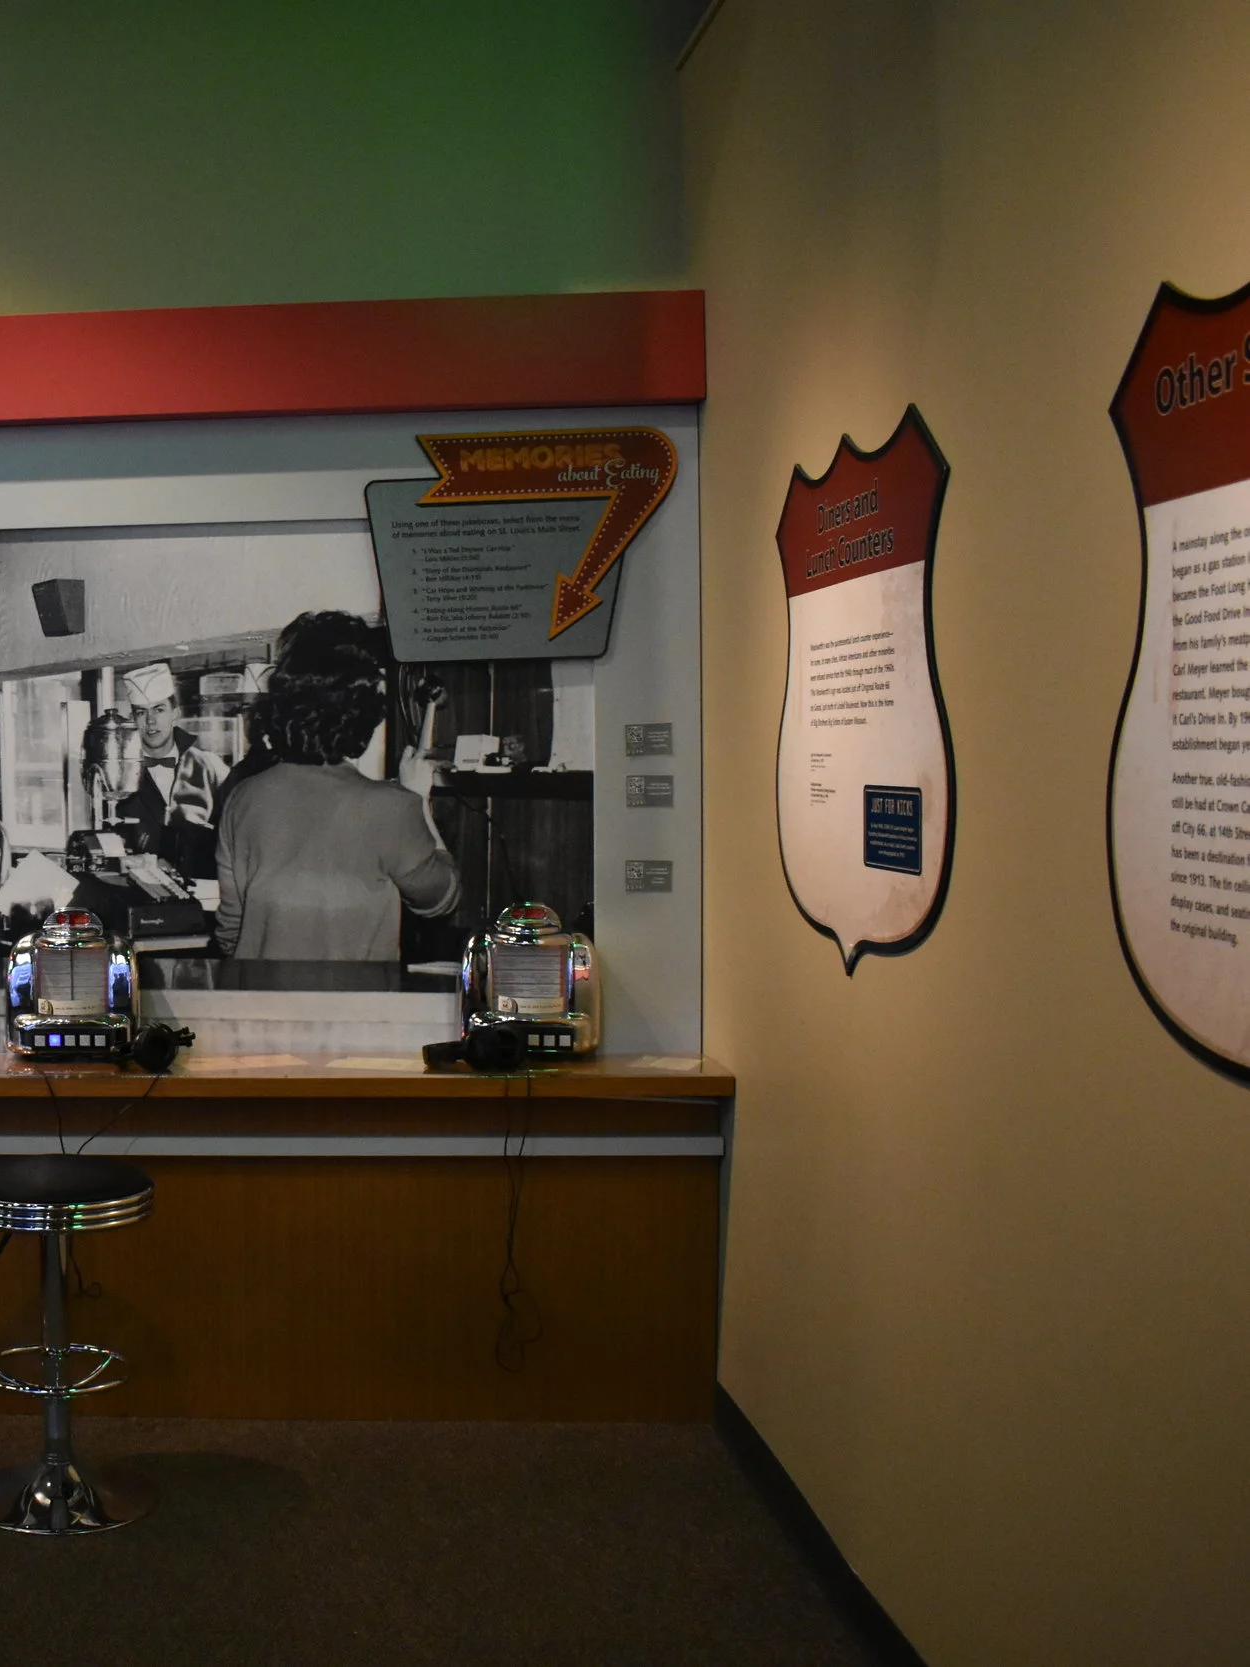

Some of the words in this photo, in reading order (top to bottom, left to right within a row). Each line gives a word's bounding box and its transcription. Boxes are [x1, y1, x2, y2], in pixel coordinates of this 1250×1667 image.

[1155, 349, 1238, 416] Other
[460, 443, 624, 472] MEMORIES
[557, 464, 600, 481] about
[604, 457, 659, 489] Eating
[817, 499, 851, 535] Diners
[854, 478, 878, 520] and
[392, 521, 413, 530] Using
[431, 519, 439, 527] of
[462, 528, 485, 538] eating
[1173, 540, 1177, 551] A
[1179, 536, 1207, 551] mainstay
[1210, 532, 1229, 546] along
[1230, 528, 1242, 540] the
[806, 539, 836, 579] Lunch
[838, 527, 894, 568] Counters
[1173, 564, 1191, 579] began
[1194, 564, 1200, 573] as
[1208, 560, 1220, 574] gas
[1222, 555, 1246, 568] station
[1173, 589, 1196, 602] became
[1198, 586, 1209, 598] the
[1211, 583, 1226, 595] Foot
[1229, 582, 1245, 595] Long
[1173, 615, 1183, 626] the
[1185, 612, 1202, 625] Good
[1204, 610, 1220, 622] Food
[1222, 608, 1241, 620] Drive
[1173, 638, 1188, 651] from
[1189, 638, 1199, 649] his
[1201, 635, 1226, 650] family's
[1173, 663, 1185, 676] Carl
[1187, 663, 1208, 678] Meyer
[1210, 659, 1234, 673] learned
[1237, 658, 1248, 670] the
[1173, 688, 1206, 701] restaurant.
[1208, 686, 1230, 701] Meyer
[1179, 712, 1196, 725] Carl's
[1198, 712, 1216, 724] Drive
[1229, 712, 1237, 727] By
[1173, 738, 1217, 751] establishment
[1219, 738, 1240, 754] began
[1172, 772, 1198, 785] Another
[1199, 774, 1214, 786] true,
[871, 798, 883, 813] JUST
[885, 798, 895, 814] FOR
[897, 800, 914, 817] KICKS
[1172, 797, 1184, 809] still
[1185, 799, 1193, 810] be
[1194, 798, 1206, 811] had
[1208, 800, 1214, 811] at
[1217, 799, 1239, 812] Crown
[1172, 820, 1181, 833] off
[1182, 822, 1194, 838] City
[1209, 825, 1216, 837] at
[1218, 825, 1233, 838] 14th
[1172, 844, 1182, 858] has
[1184, 846, 1199, 860] been
[1207, 849, 1245, 865] destination
[1171, 871, 1187, 884] since
[1189, 873, 1206, 887] 1913.
[1209, 875, 1221, 889] The
[1223, 877, 1232, 890] tin
[1171, 894, 1193, 912] display
[1195, 900, 1213, 913] cases,
[1216, 903, 1229, 916] and
[1171, 918, 1180, 932] the
[1182, 922, 1207, 939] original
[1208, 925, 1239, 948] building.
